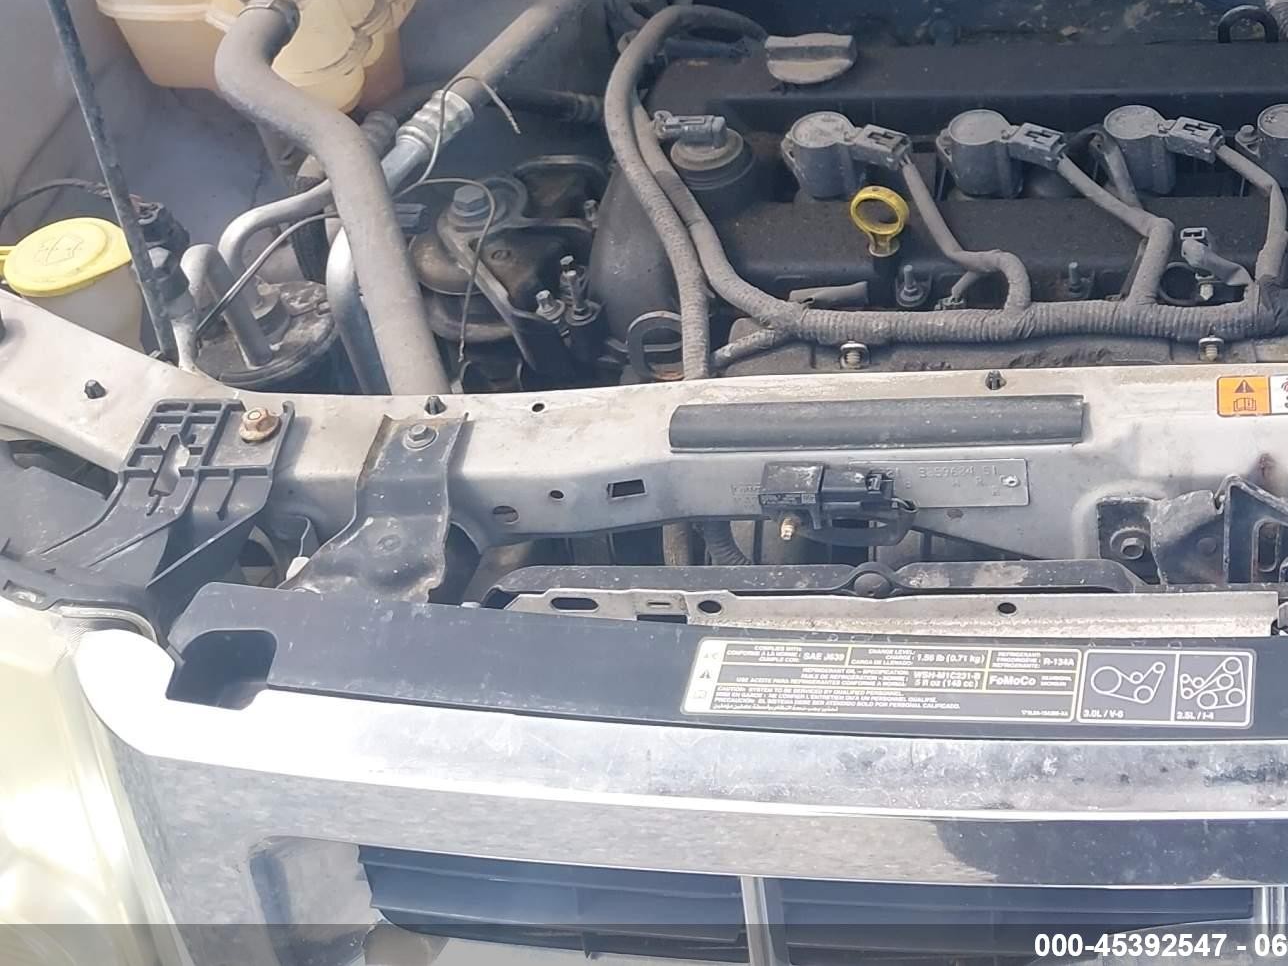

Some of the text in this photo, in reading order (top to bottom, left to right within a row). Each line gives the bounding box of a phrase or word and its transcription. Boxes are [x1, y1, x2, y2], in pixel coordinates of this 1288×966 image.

[803, 652, 823, 661] SAE
[946, 653, 968, 664] (0.71
[970, 654, 985, 664] kg)
[1043, 657, 1075, 667] R-134A
[989, 674, 1037, 686] FoMoCo
[1110, 710, 1124, 719] V-6
